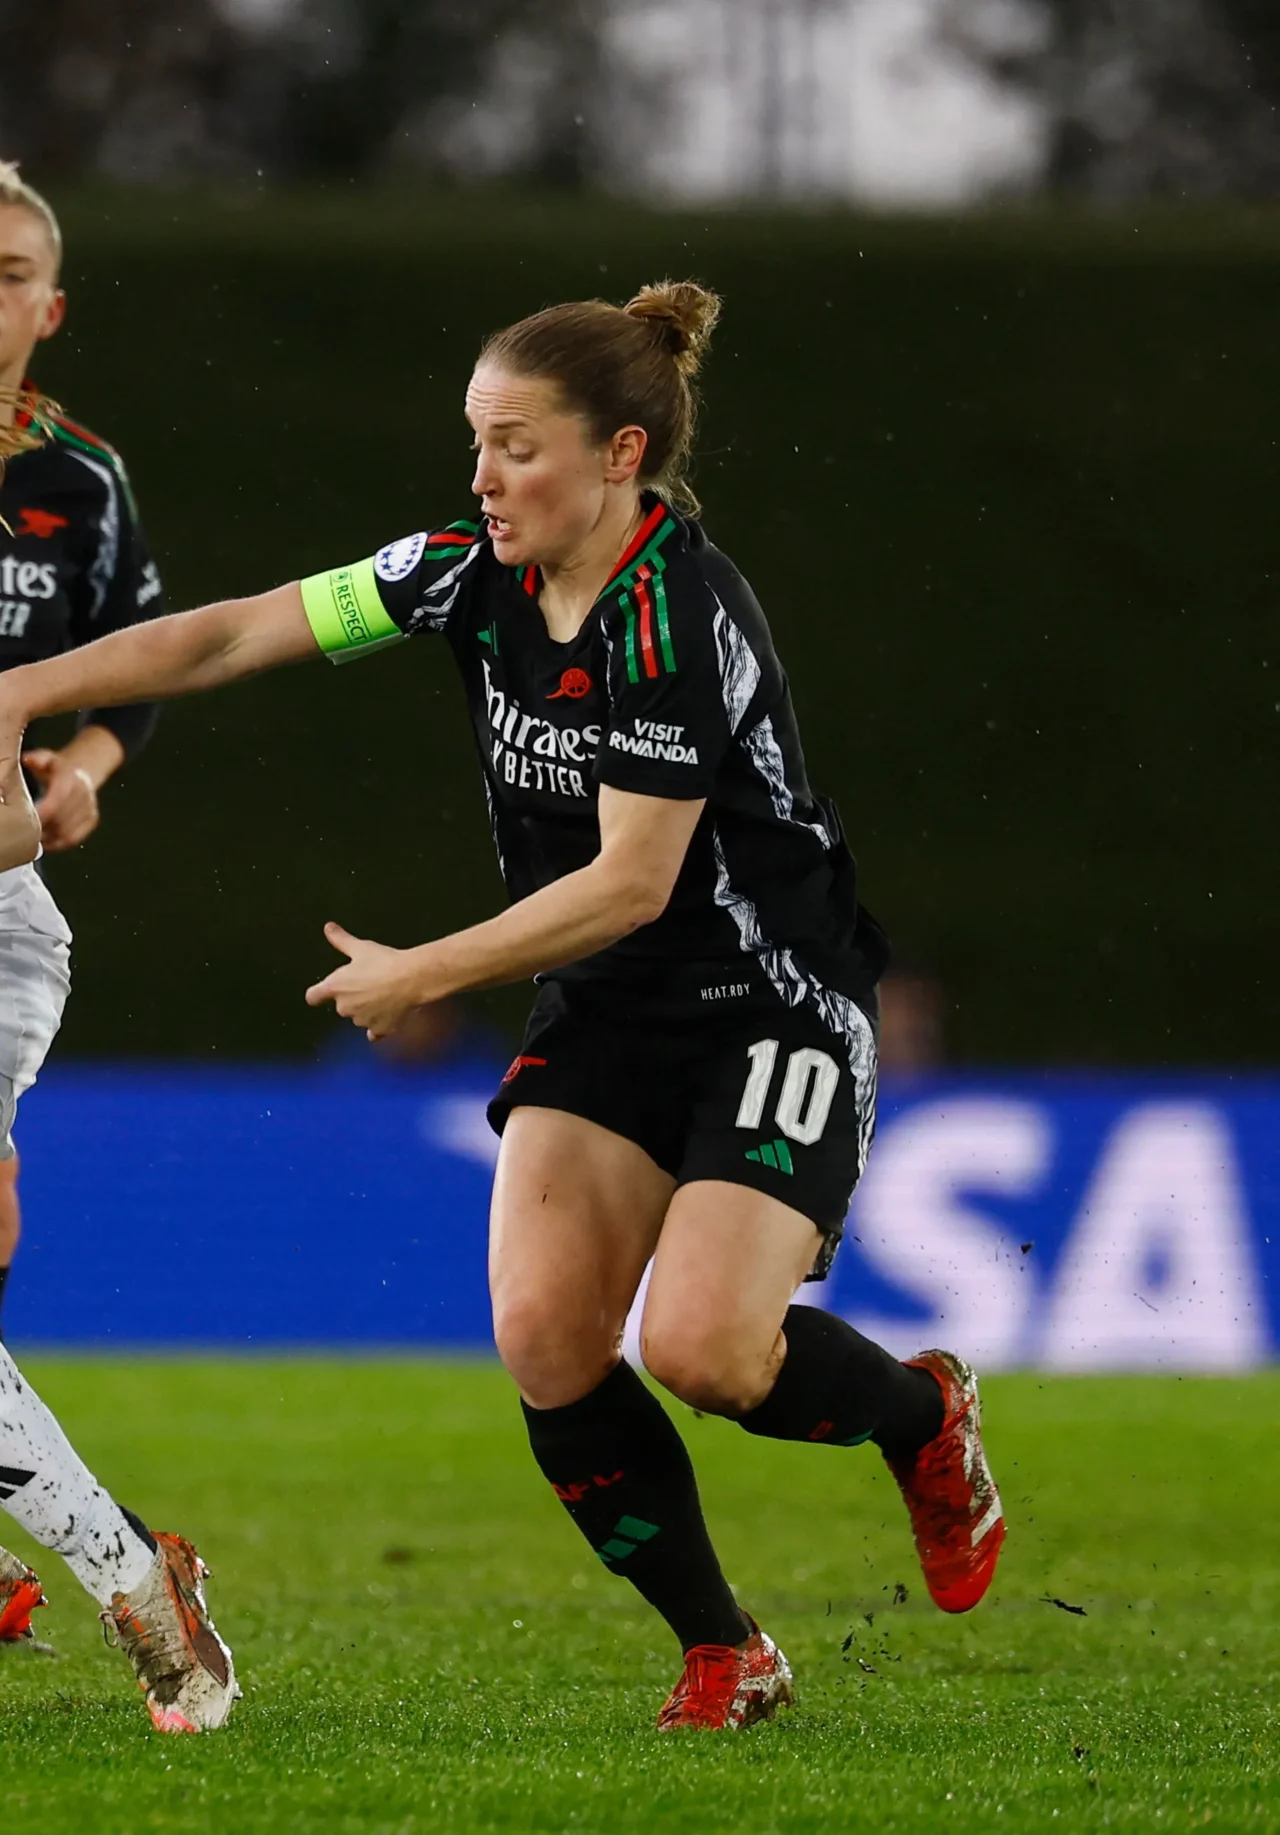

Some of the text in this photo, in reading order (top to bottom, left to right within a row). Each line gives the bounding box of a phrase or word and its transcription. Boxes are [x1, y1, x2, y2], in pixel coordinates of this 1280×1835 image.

[336, 584, 367, 640] RESPECT
[609, 731, 699, 764] RWANDA
[634, 718, 684, 743] VISIT
[504, 750, 588, 797] BETTER
[701, 983, 750, 1000] HEAT.RDY
[735, 1038, 840, 1146] 10
